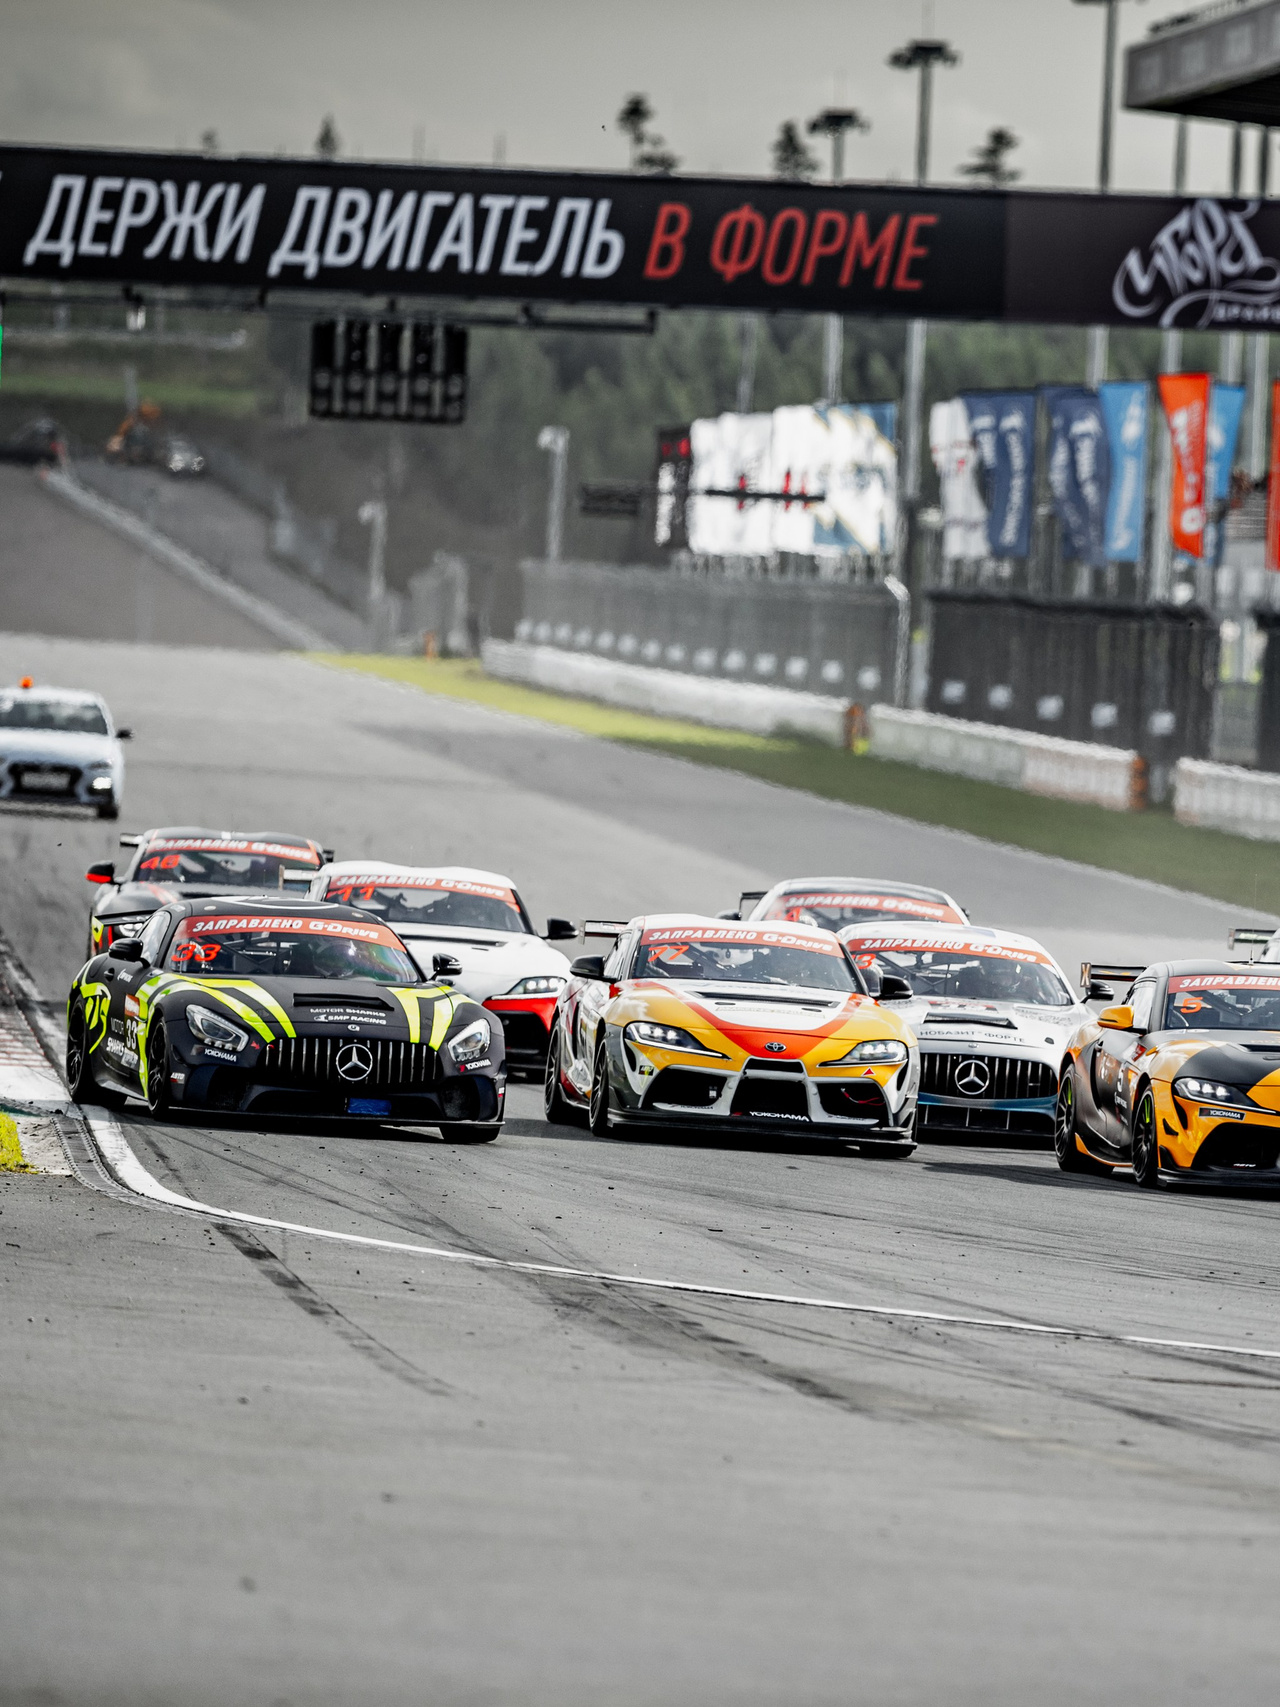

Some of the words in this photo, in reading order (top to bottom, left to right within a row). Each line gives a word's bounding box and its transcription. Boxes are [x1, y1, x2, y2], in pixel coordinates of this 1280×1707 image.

[23, 174, 267, 267] ДЕРЖИ
[267, 186, 625, 279] ДВИГАТЕЛЬ
[643, 203, 692, 279] В
[710, 204, 938, 291] ФОРМЕ
[192, 918, 303, 932] ЗАПРАВЛЕНО
[649, 930, 757, 941] ЗАПРАВЛЕНО
[860, 938, 965, 950] ЗАПРАВЛЕНО
[171, 943, 221, 962] 33
[648, 945, 689, 962] 77
[1180, 997, 1203, 1013] 5
[346, 1008, 386, 1017] SHARKS
[351, 1015, 387, 1025] RACING
[204, 1048, 237, 1062] YOKOHAMA
[750, 1111, 810, 1122] YOKOHAMA
[1209, 1110, 1241, 1119] YOKOHAMA
